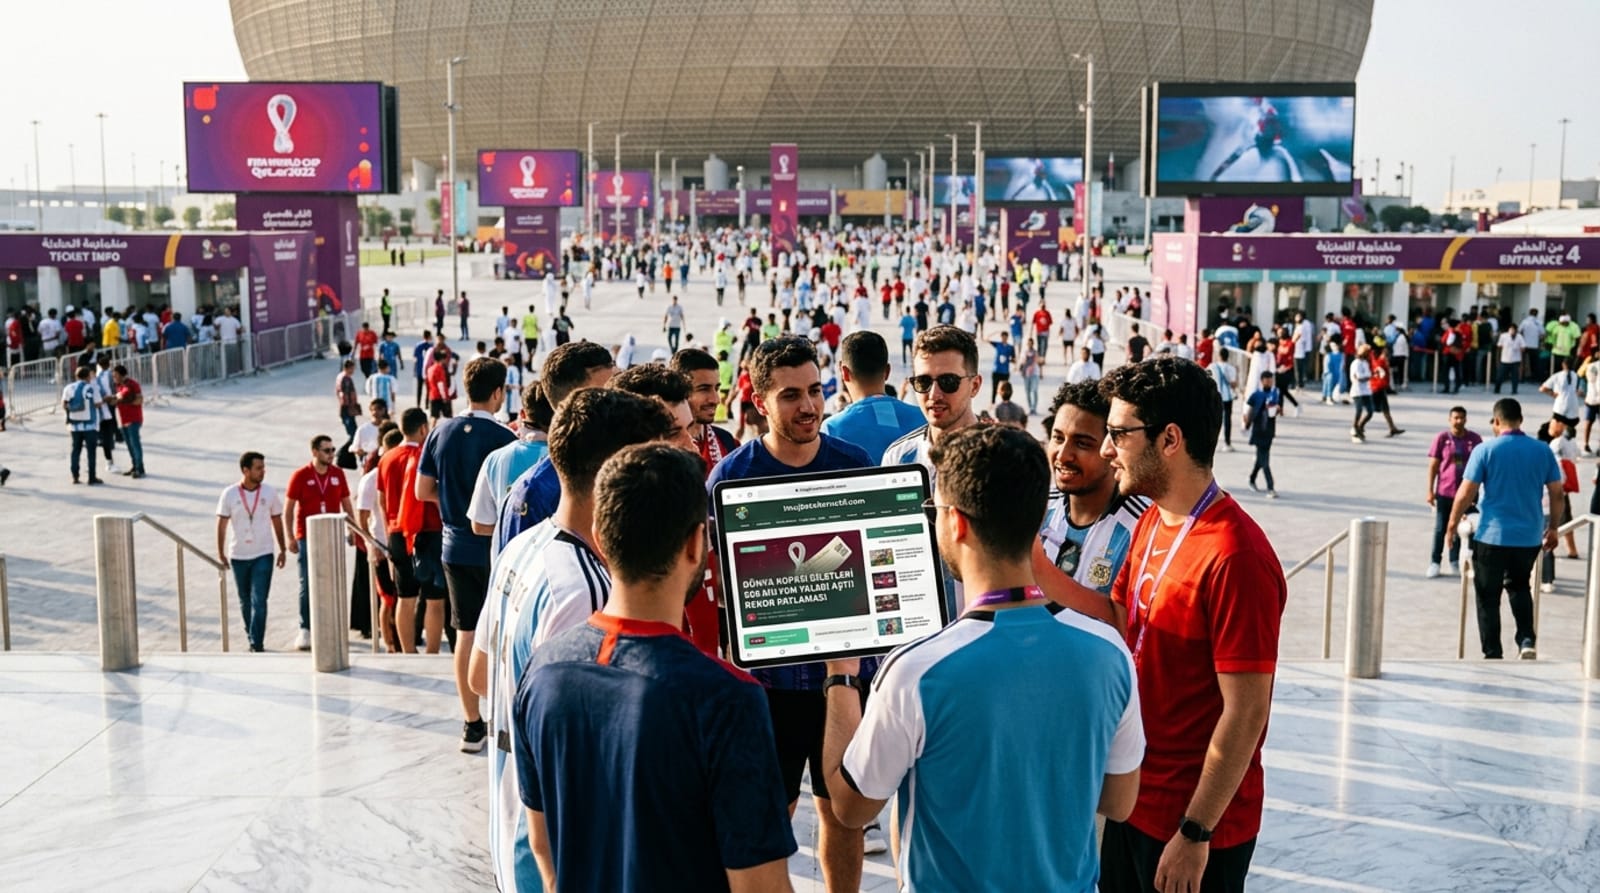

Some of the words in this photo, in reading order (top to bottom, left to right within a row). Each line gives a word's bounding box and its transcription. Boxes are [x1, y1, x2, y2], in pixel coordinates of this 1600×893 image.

[1499, 254, 1564, 266] ENTRANCE
[1565, 244, 1582, 264] 4
[744, 598, 776, 609] REKOR
